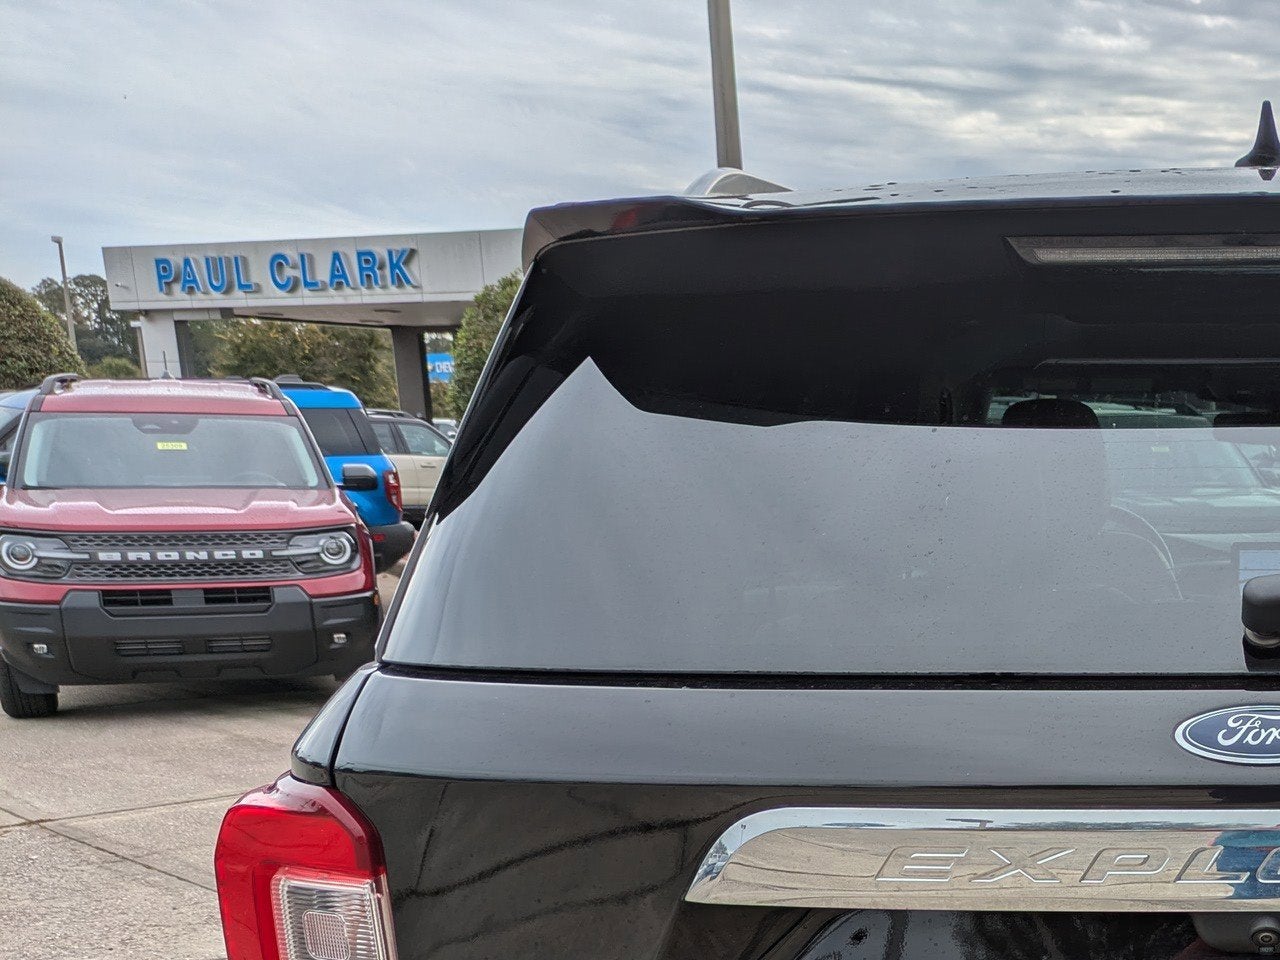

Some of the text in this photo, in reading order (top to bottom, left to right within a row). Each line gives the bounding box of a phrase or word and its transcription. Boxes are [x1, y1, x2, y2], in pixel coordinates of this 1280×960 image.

[154, 246, 414, 293] PAUL CLARK
[98, 549, 264, 561] BRONCO
